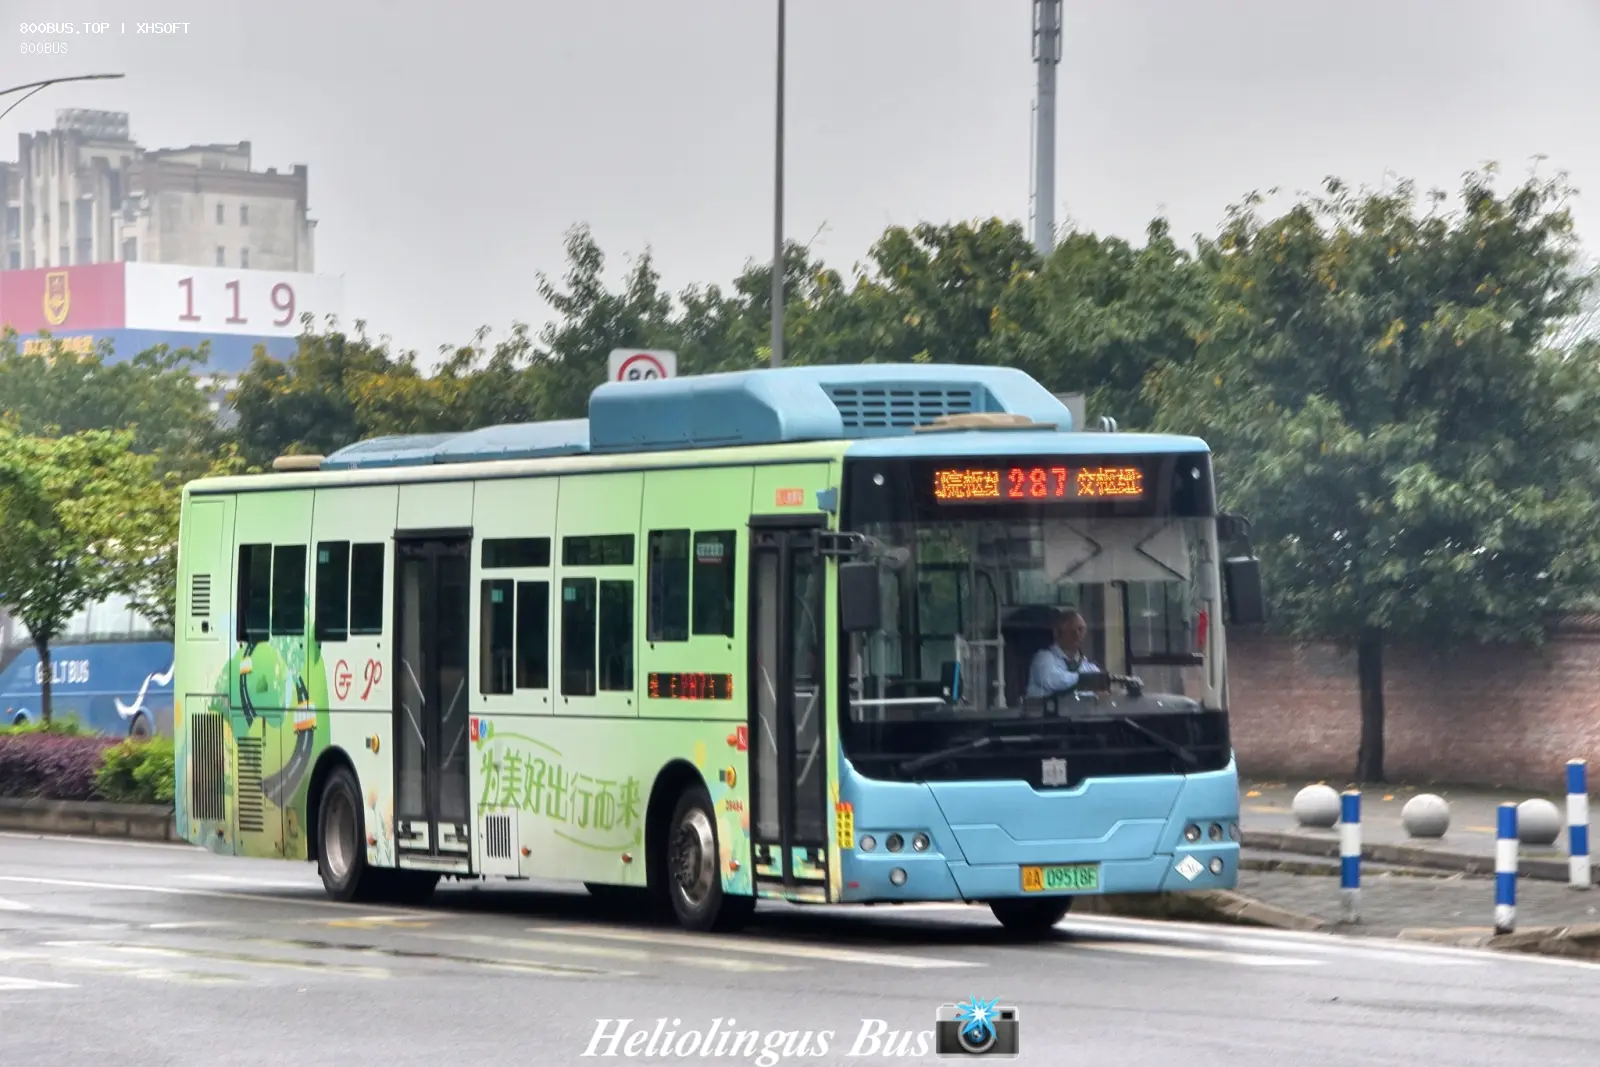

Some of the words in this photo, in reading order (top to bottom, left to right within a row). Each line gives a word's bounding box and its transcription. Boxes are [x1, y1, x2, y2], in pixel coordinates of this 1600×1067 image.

[177, 275, 297, 327] 119
[1007, 467, 1067, 498] 287
[68, 658, 90, 685] BUS
[479, 745, 641, 831] 为美好出行而来
